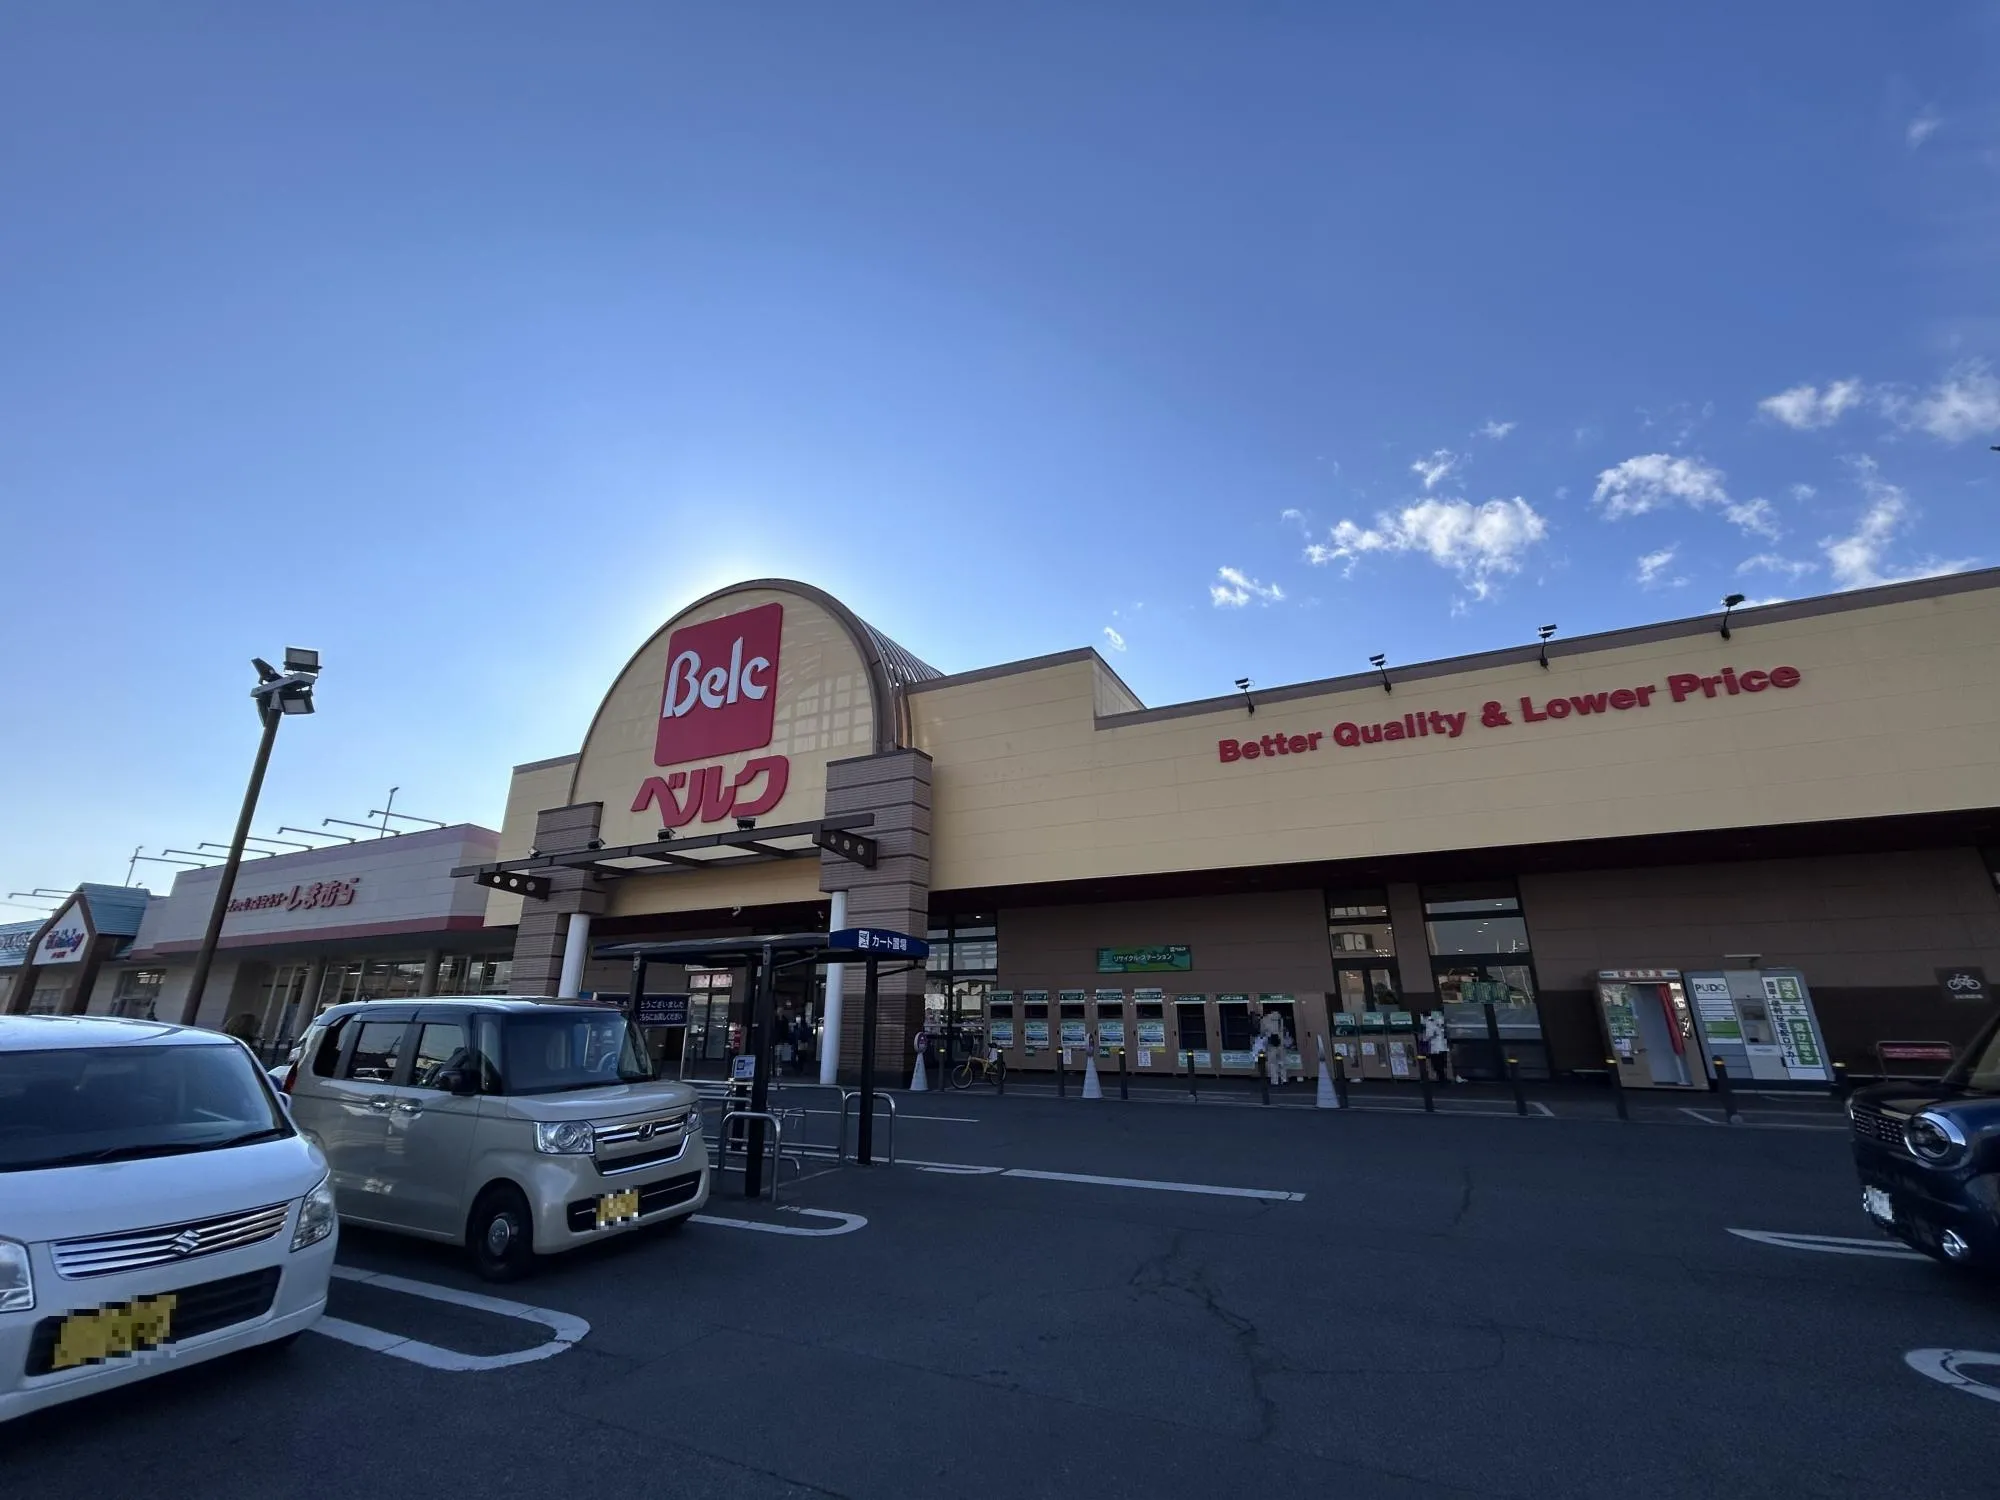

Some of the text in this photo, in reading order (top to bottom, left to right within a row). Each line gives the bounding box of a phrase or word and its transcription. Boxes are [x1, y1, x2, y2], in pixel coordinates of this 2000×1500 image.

[662, 636, 771, 718] Belc
[1218, 666, 1801, 763] Better Quality & Lower Price
[630, 754, 789, 828] ベルク
[1695, 984, 1726, 992] PUDO
